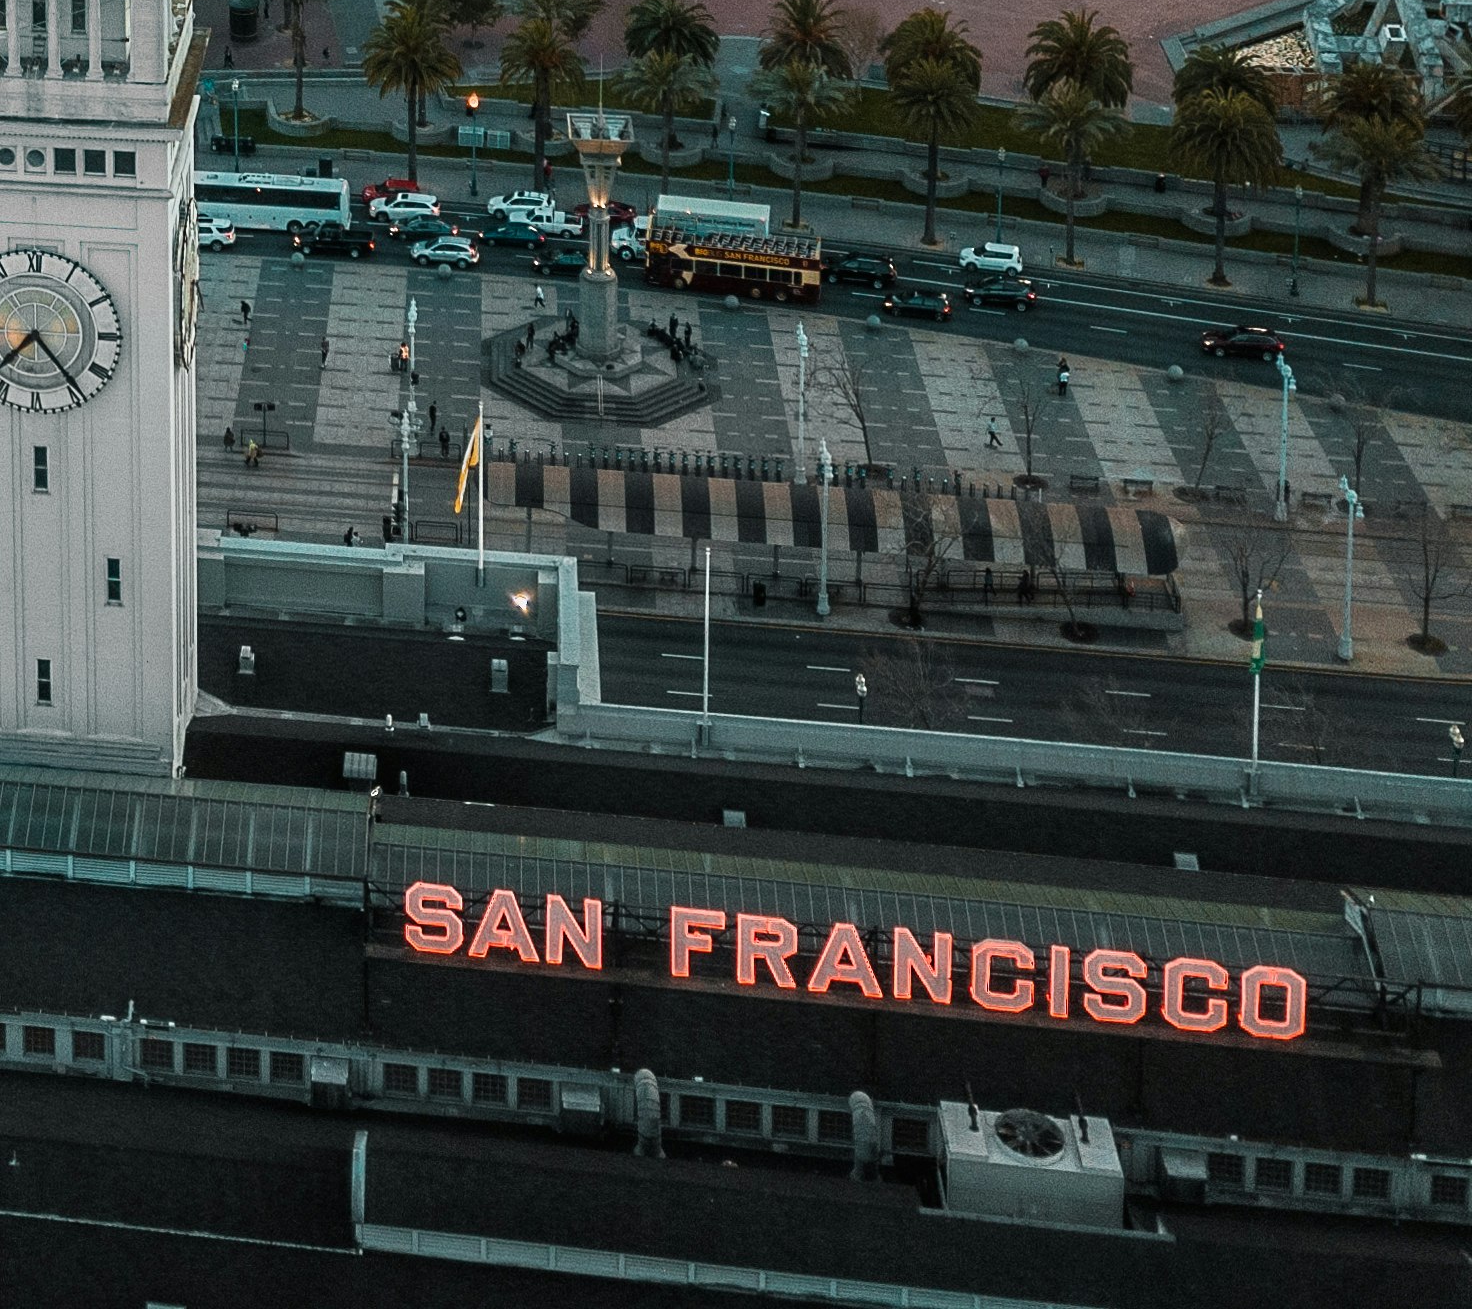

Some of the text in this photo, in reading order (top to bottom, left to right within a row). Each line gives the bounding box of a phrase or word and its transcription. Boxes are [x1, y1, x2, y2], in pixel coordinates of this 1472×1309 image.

[724, 250, 742, 260] SAN
[743, 253, 790, 266] FRANCISCO
[404, 881, 1307, 1040] SAN FRANCISCO
